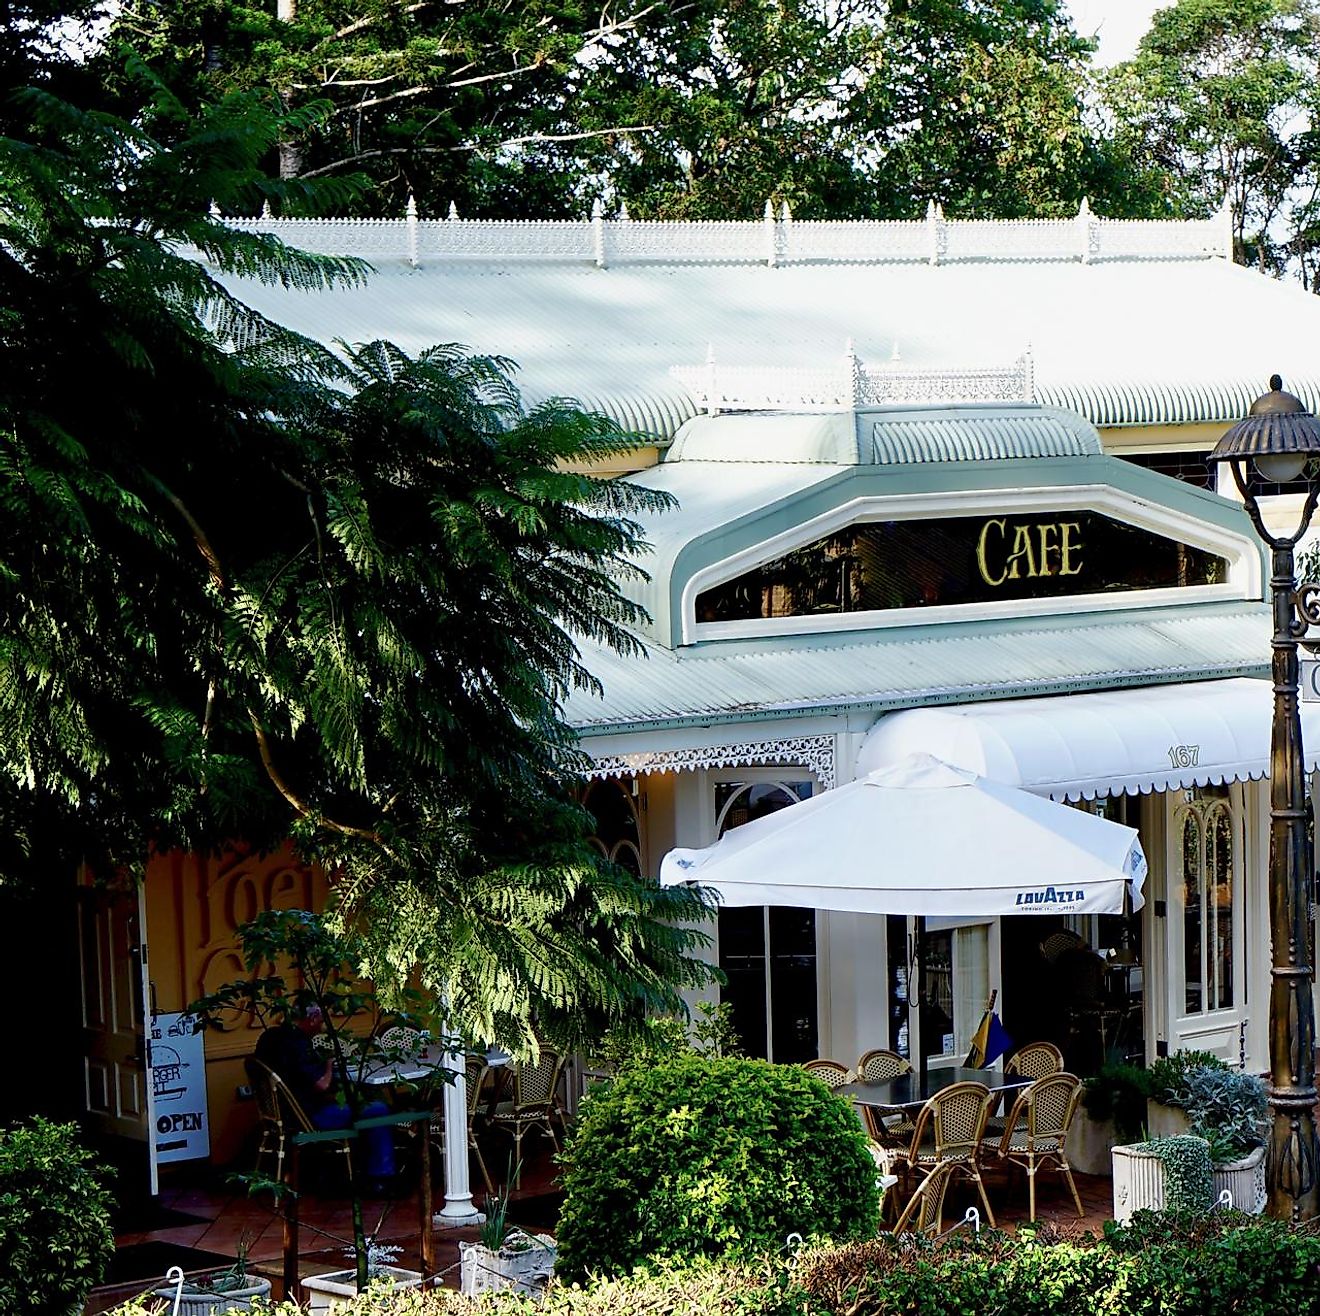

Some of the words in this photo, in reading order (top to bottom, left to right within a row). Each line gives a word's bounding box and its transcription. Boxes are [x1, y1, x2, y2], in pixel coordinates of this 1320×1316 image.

[976, 518, 1083, 586] CAFE
[1167, 744, 1200, 769] 167
[1015, 886, 1085, 906] LAVAZZA
[156, 1112, 204, 1135] OPEN
